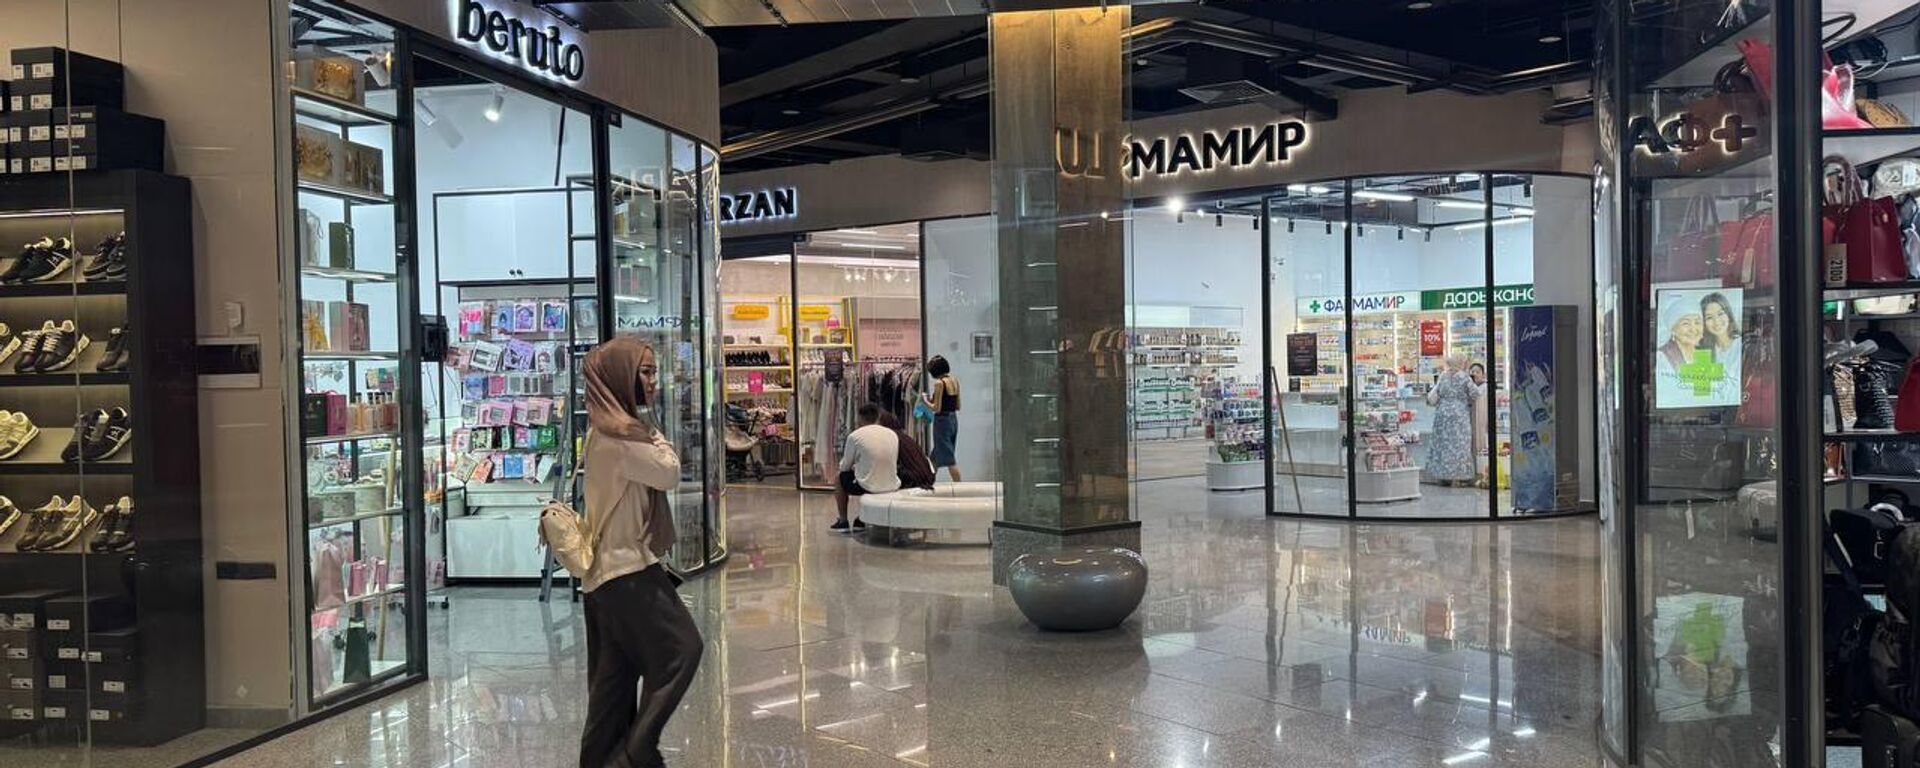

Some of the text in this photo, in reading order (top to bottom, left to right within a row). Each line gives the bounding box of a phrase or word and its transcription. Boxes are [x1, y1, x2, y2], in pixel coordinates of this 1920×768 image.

[457, 0, 584, 81] beruto
[1123, 120, 1306, 178] МАМИР
[716, 187, 796, 221] RZAN
[1323, 295, 1405, 312] ФАМАМИР
